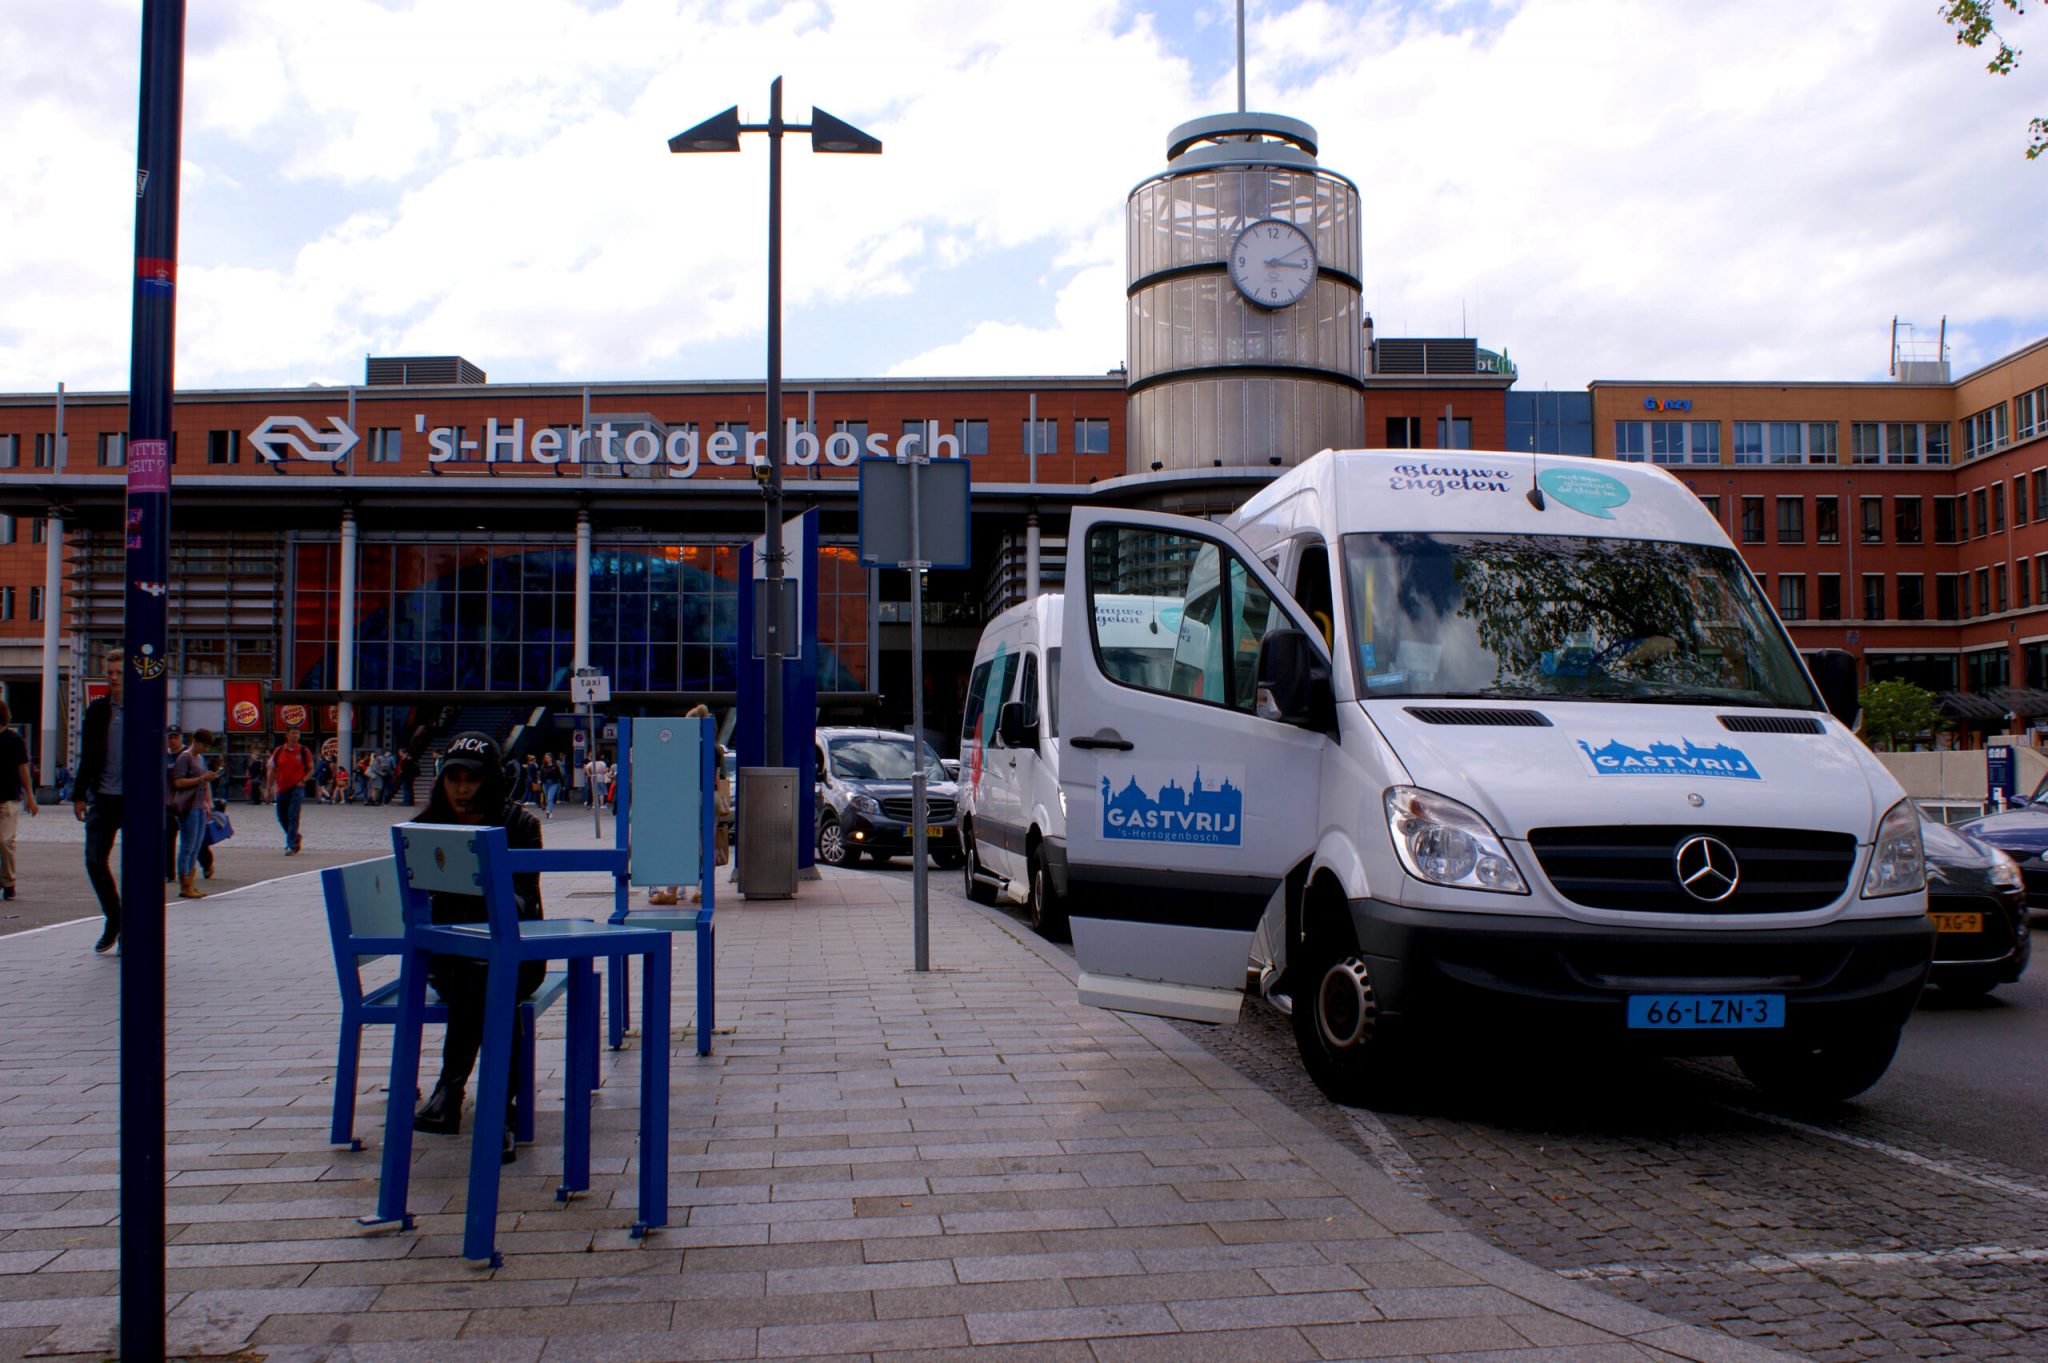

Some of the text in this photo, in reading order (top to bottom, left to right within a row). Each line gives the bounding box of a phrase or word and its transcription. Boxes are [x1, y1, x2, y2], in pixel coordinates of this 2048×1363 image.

[1267, 228, 1279, 239] 12
[1239, 257, 1246, 268] 9
[1301, 258, 1308, 270] 3
[1270, 287, 1278, 299] 6
[1644, 397, 1692, 412] Gynzy
[415, 414, 960, 478] 's-Hertogenbosch
[1394, 464, 1513, 479] Blauwe
[1389, 477, 1510, 497] Engelen
[1095, 606, 1143, 615] lauwe
[1096, 615, 1142, 626] gelen
[581, 679, 601, 687] taxi
[237, 711, 256, 720] KING
[284, 711, 304, 720] KING
[448, 738, 488, 753] JACK
[1597, 756, 1748, 772] GASTVRIJ
[1615, 766, 1736, 777] 's-Hertogenbosch
[1107, 808, 1236, 833] GASTVRIJ
[1118, 828, 1219, 842] 's-Hertogenbosch
[1932, 914, 1976, 930] TXG-9
[1647, 1000, 1767, 1024] 66-LZN-3
